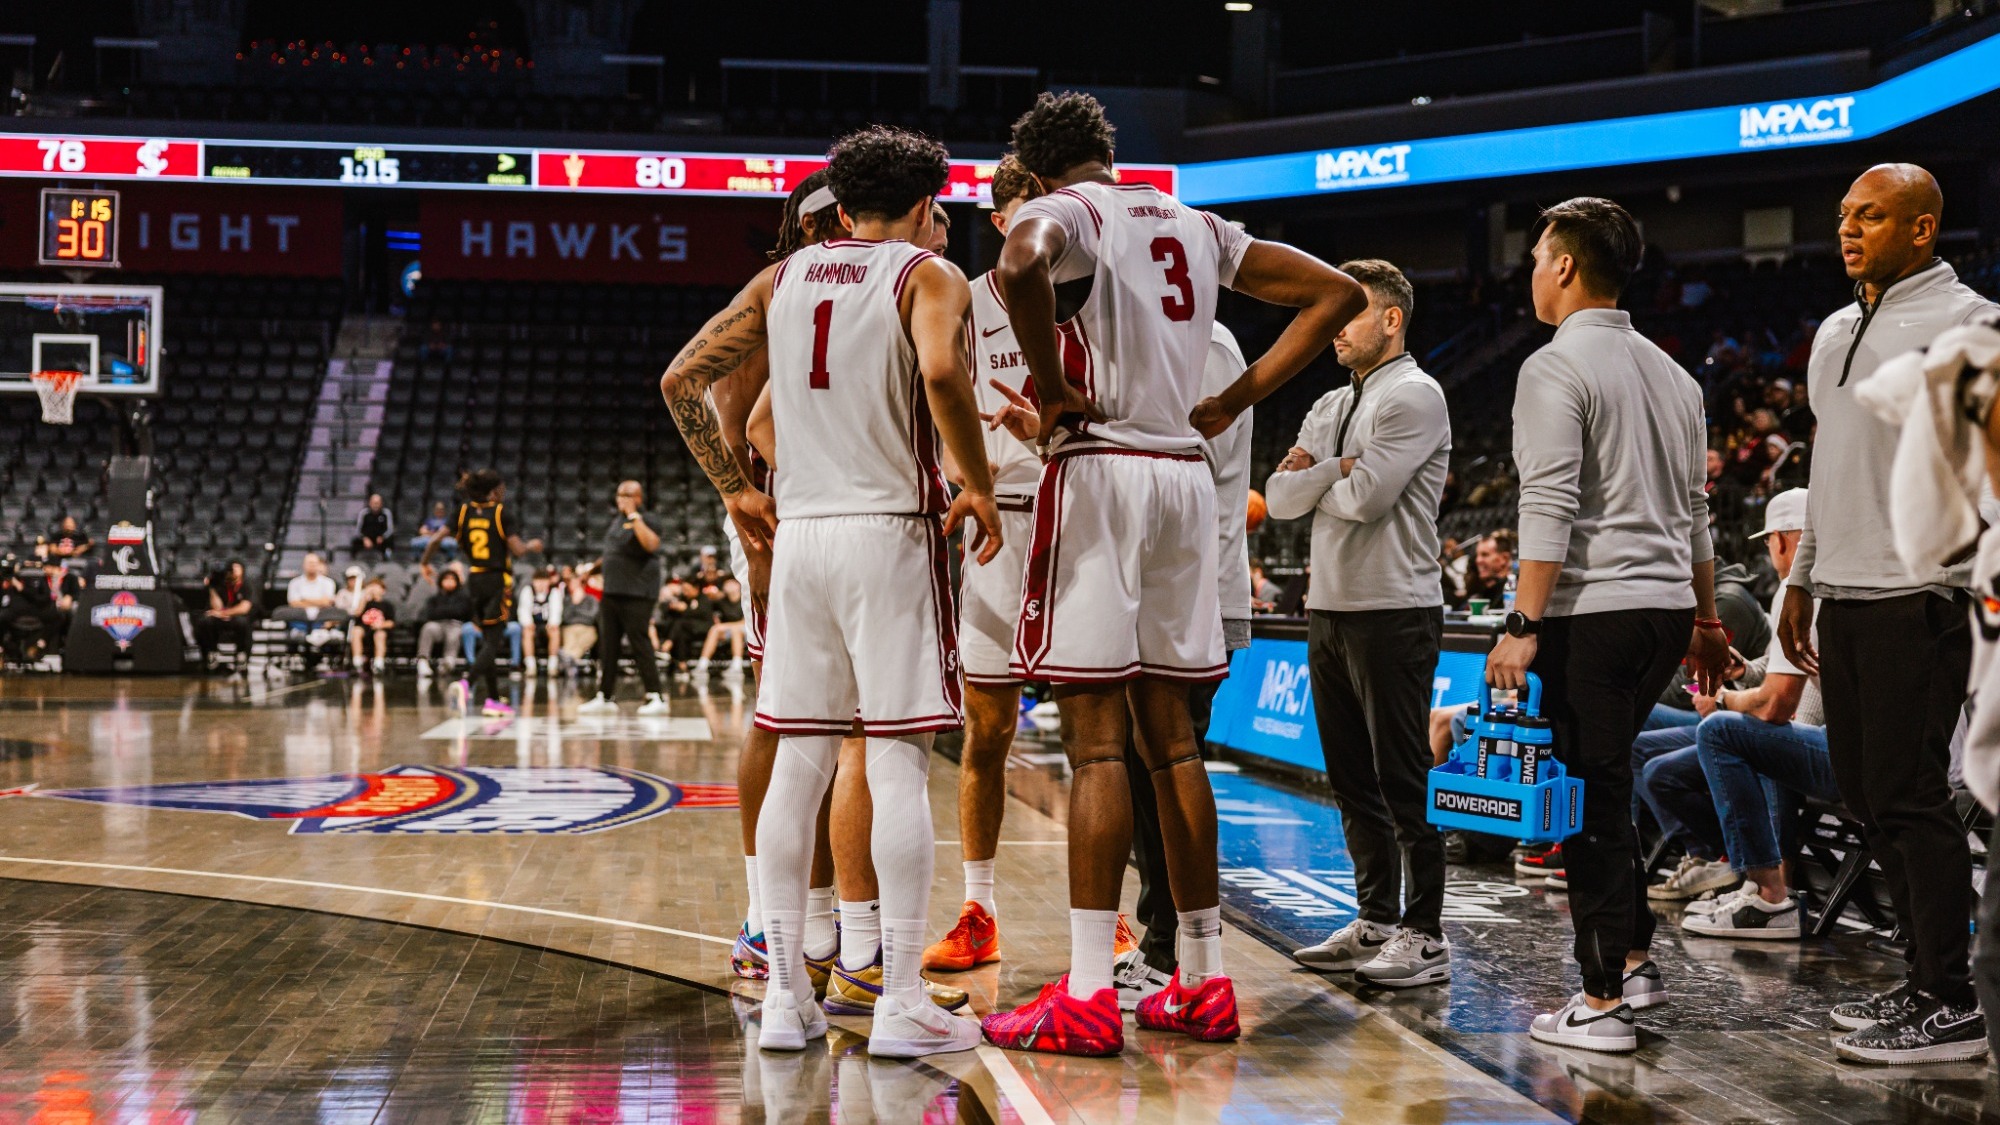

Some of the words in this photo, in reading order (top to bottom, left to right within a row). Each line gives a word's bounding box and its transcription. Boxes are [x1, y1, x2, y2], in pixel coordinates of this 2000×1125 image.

[1738, 97, 1855, 138] IMPACT
[38, 140, 86, 171] 76
[340, 157, 400, 184] 1:15
[635, 157, 686, 188] 80
[1316, 144, 1411, 181] IMPACT
[71, 199, 111, 222] 1:15
[58, 219, 105, 258] 30
[461, 219, 688, 261] HAWKS
[804, 262, 868, 285] HAMMOND
[1150, 237, 1195, 322] 3
[809, 299, 834, 390] 1
[469, 529, 491, 560] 2
[1478, 740, 1488, 779] RADE
[1436, 792, 1519, 818] POWERADE
